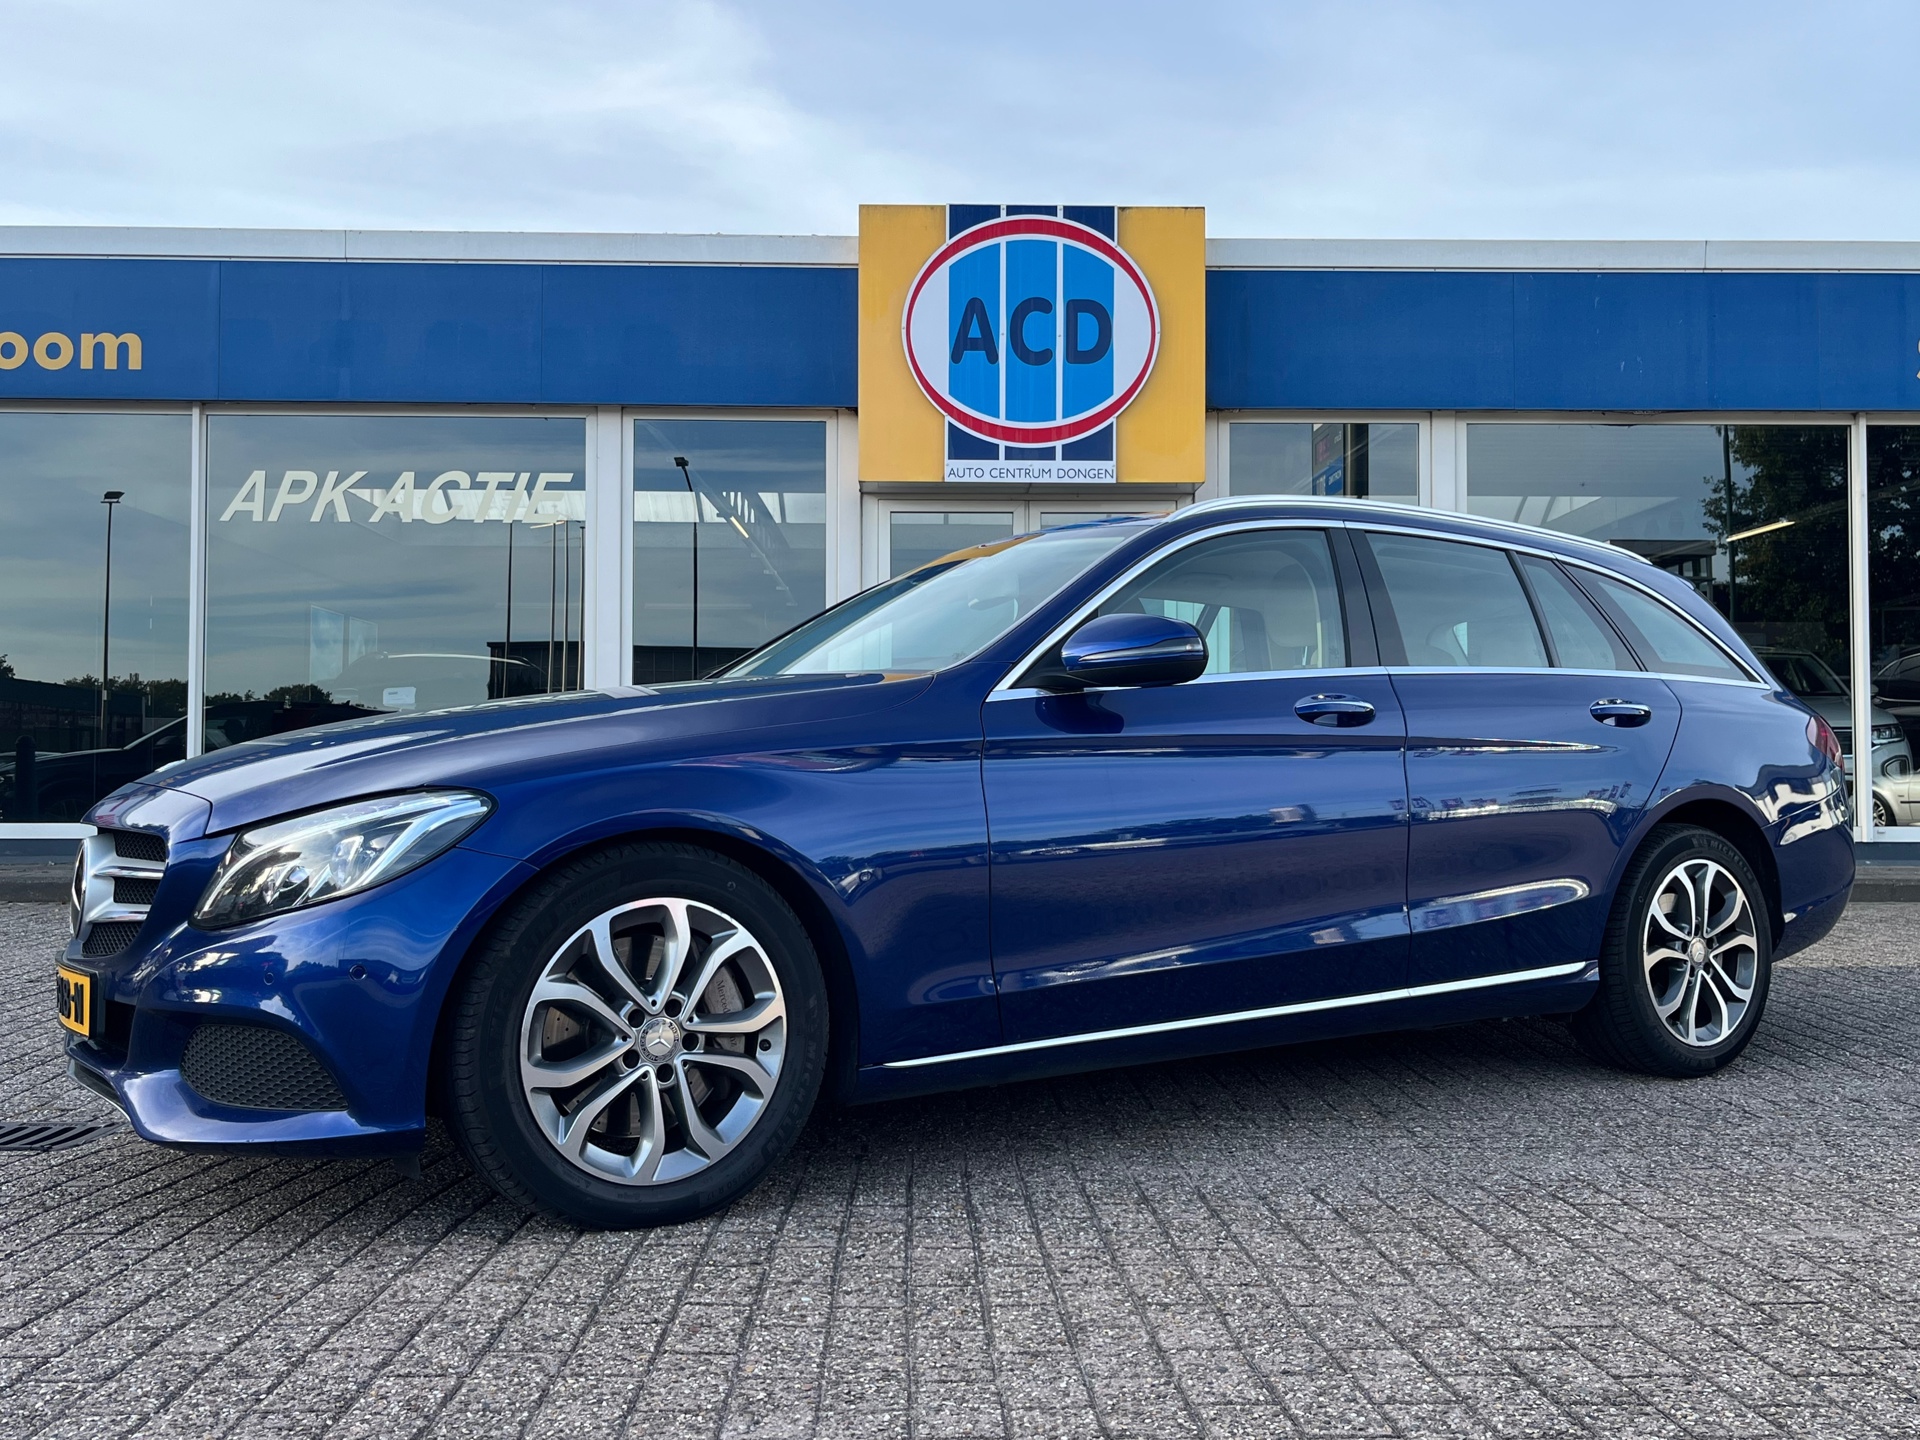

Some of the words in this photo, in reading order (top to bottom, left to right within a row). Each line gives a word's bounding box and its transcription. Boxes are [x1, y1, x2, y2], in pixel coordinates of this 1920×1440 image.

[0, 331, 142, 370] oom
[950, 296, 1112, 366] ACD
[947, 467, 985, 479] AUTO
[989, 467, 1052, 479] CENTRUM
[1056, 467, 1114, 480] DONGEN
[219, 470, 369, 522] APK
[368, 470, 574, 524] ACTIE
